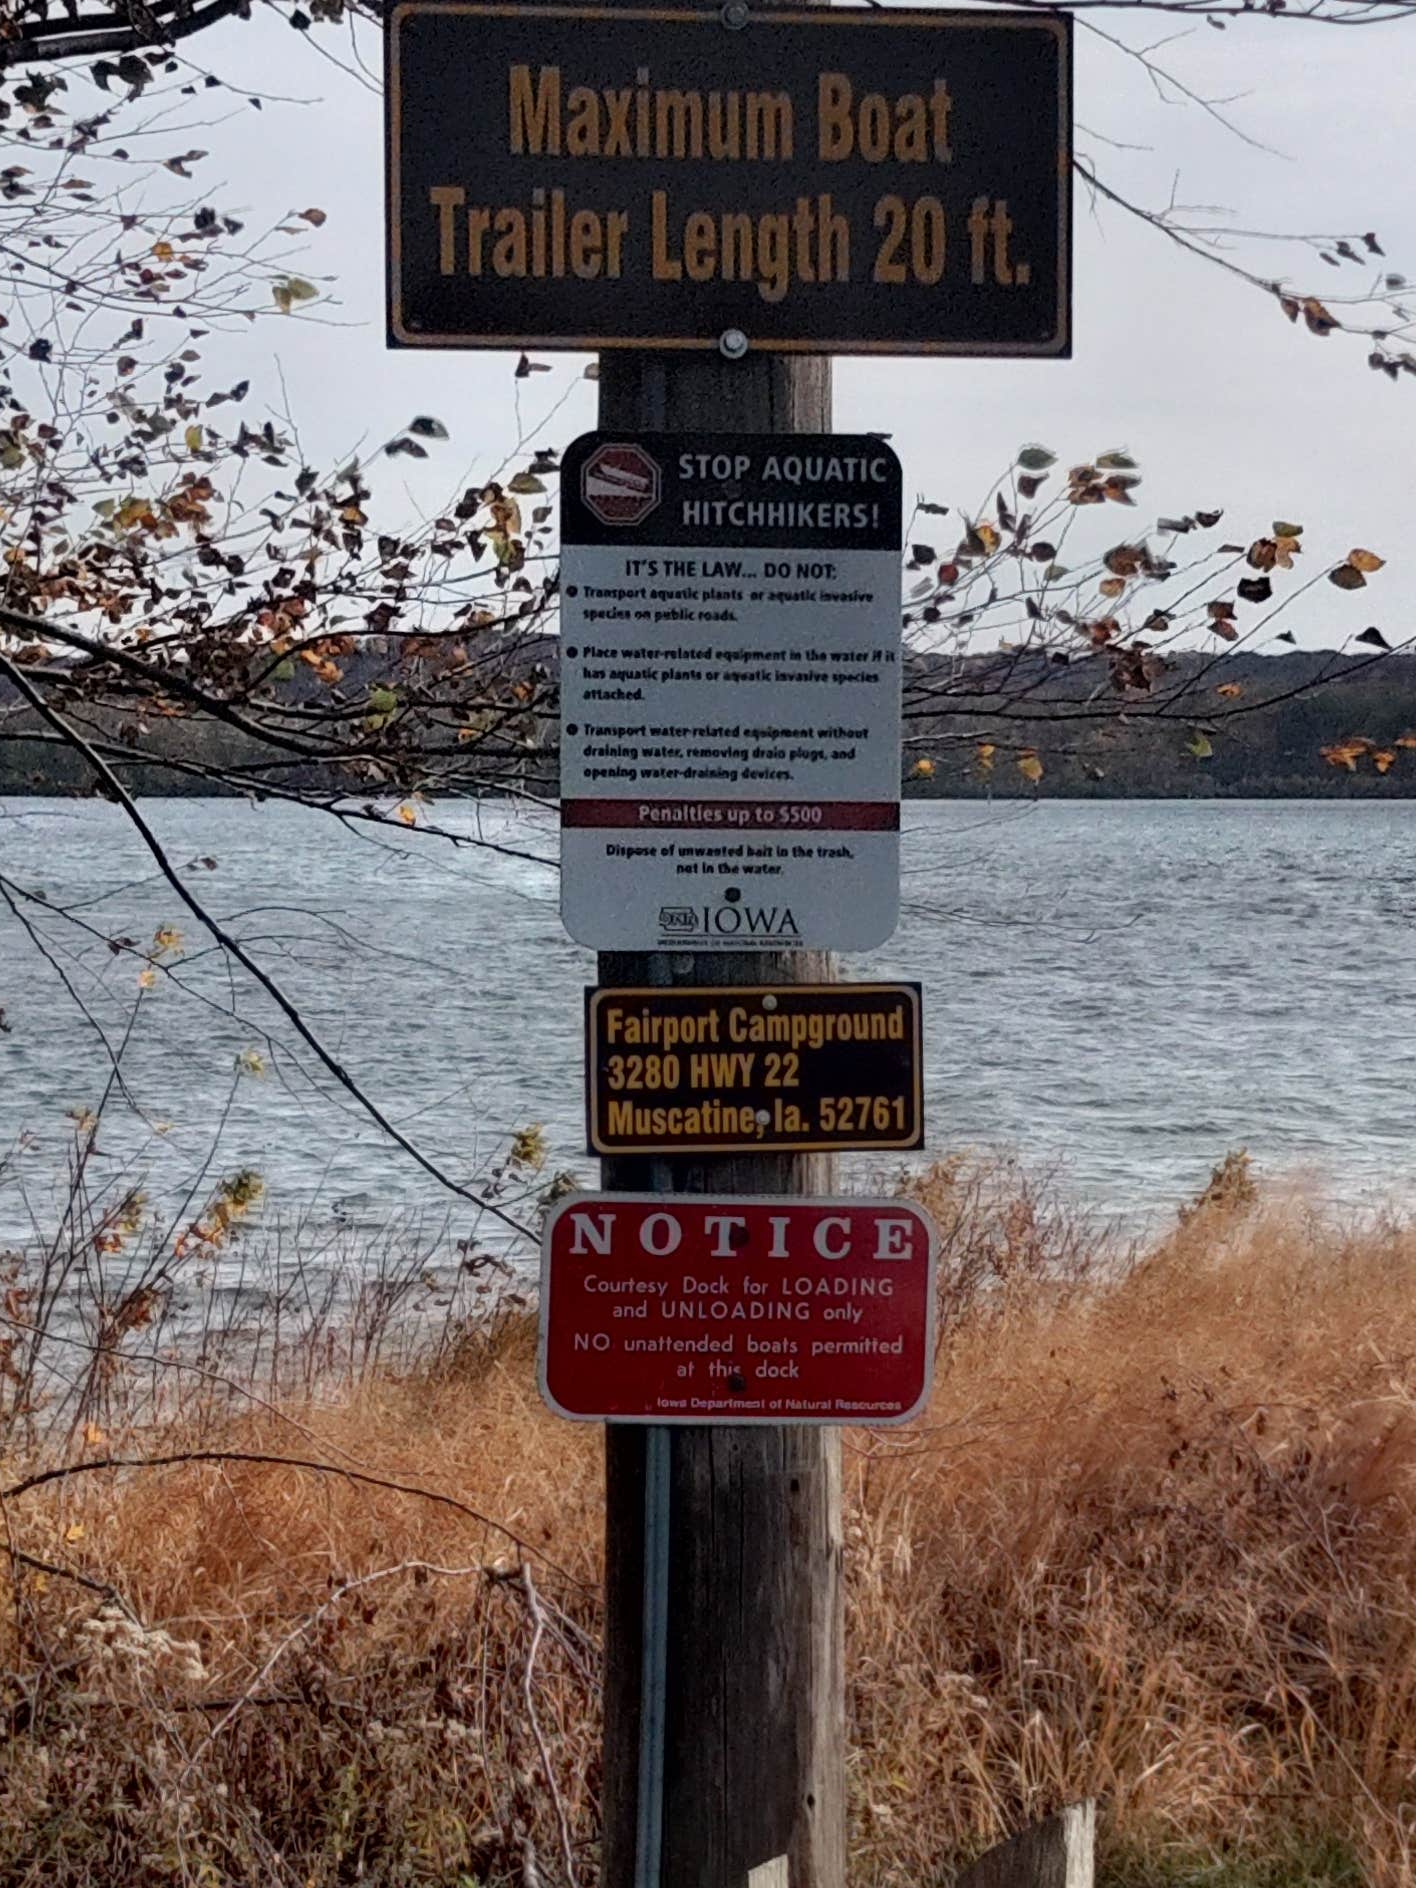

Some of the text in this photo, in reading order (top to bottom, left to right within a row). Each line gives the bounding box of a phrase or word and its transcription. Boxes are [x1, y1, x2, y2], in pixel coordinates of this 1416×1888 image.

[510, 65, 953, 164] Maximum Boat
[429, 185, 1031, 303] Trailer Length 20 ft.
[679, 454, 887, 486] STOP AQUATIC
[683, 500, 879, 529] HITCHHIKERS!
[663, 560, 696, 577] THE
[702, 561, 757, 578] LAW...
[765, 563, 791, 579] DO
[796, 563, 837, 580] NOT:
[583, 586, 873, 605] Transport aquatic plants or aquatic invasive
[583, 606, 630, 621] species
[634, 610, 651, 620] on
[655, 608, 695, 623] public
[583, 646, 895, 663] Place water-related equipment in the water if it
[583, 668, 879, 686] has aquatic plants or aquatic invasive species
[583, 689, 645, 701] attached.
[583, 724, 868, 741] Transport water-related equipment without
[583, 745, 638, 760] draining
[686, 748, 749, 761] removing
[752, 746, 786, 760] drain
[831, 747, 856, 760] and
[583, 767, 637, 781] opening
[641, 768, 738, 782] water-draining
[639, 806, 822, 824] Penalties up to $500
[606, 844, 656, 859] Dispose
[661, 844, 674, 857] of
[678, 846, 743, 858] unwanted
[747, 846, 772, 858] bait
[776, 846, 788, 858] in
[792, 846, 813, 858] the
[676, 863, 698, 874] not
[702, 863, 715, 874] in
[718, 863, 739, 874] the
[703, 906, 799, 934] IOWA
[607, 1005, 904, 1051] Fairport Campground
[608, 1052, 799, 1090] 3280 HWY 22
[608, 1095, 905, 1139] Muscatine, Ia. 52761
[569, 1213, 913, 1260] NOTICE
[584, 1274, 894, 1296] Courtesy Dock for LOADING
[613, 1301, 863, 1323] and UNLOADING only
[574, 1334, 903, 1356] NO unattended boats permitted
[677, 1361, 799, 1378] at this dock
[657, 1397, 901, 1410] Iowa Department of Natural Resources
